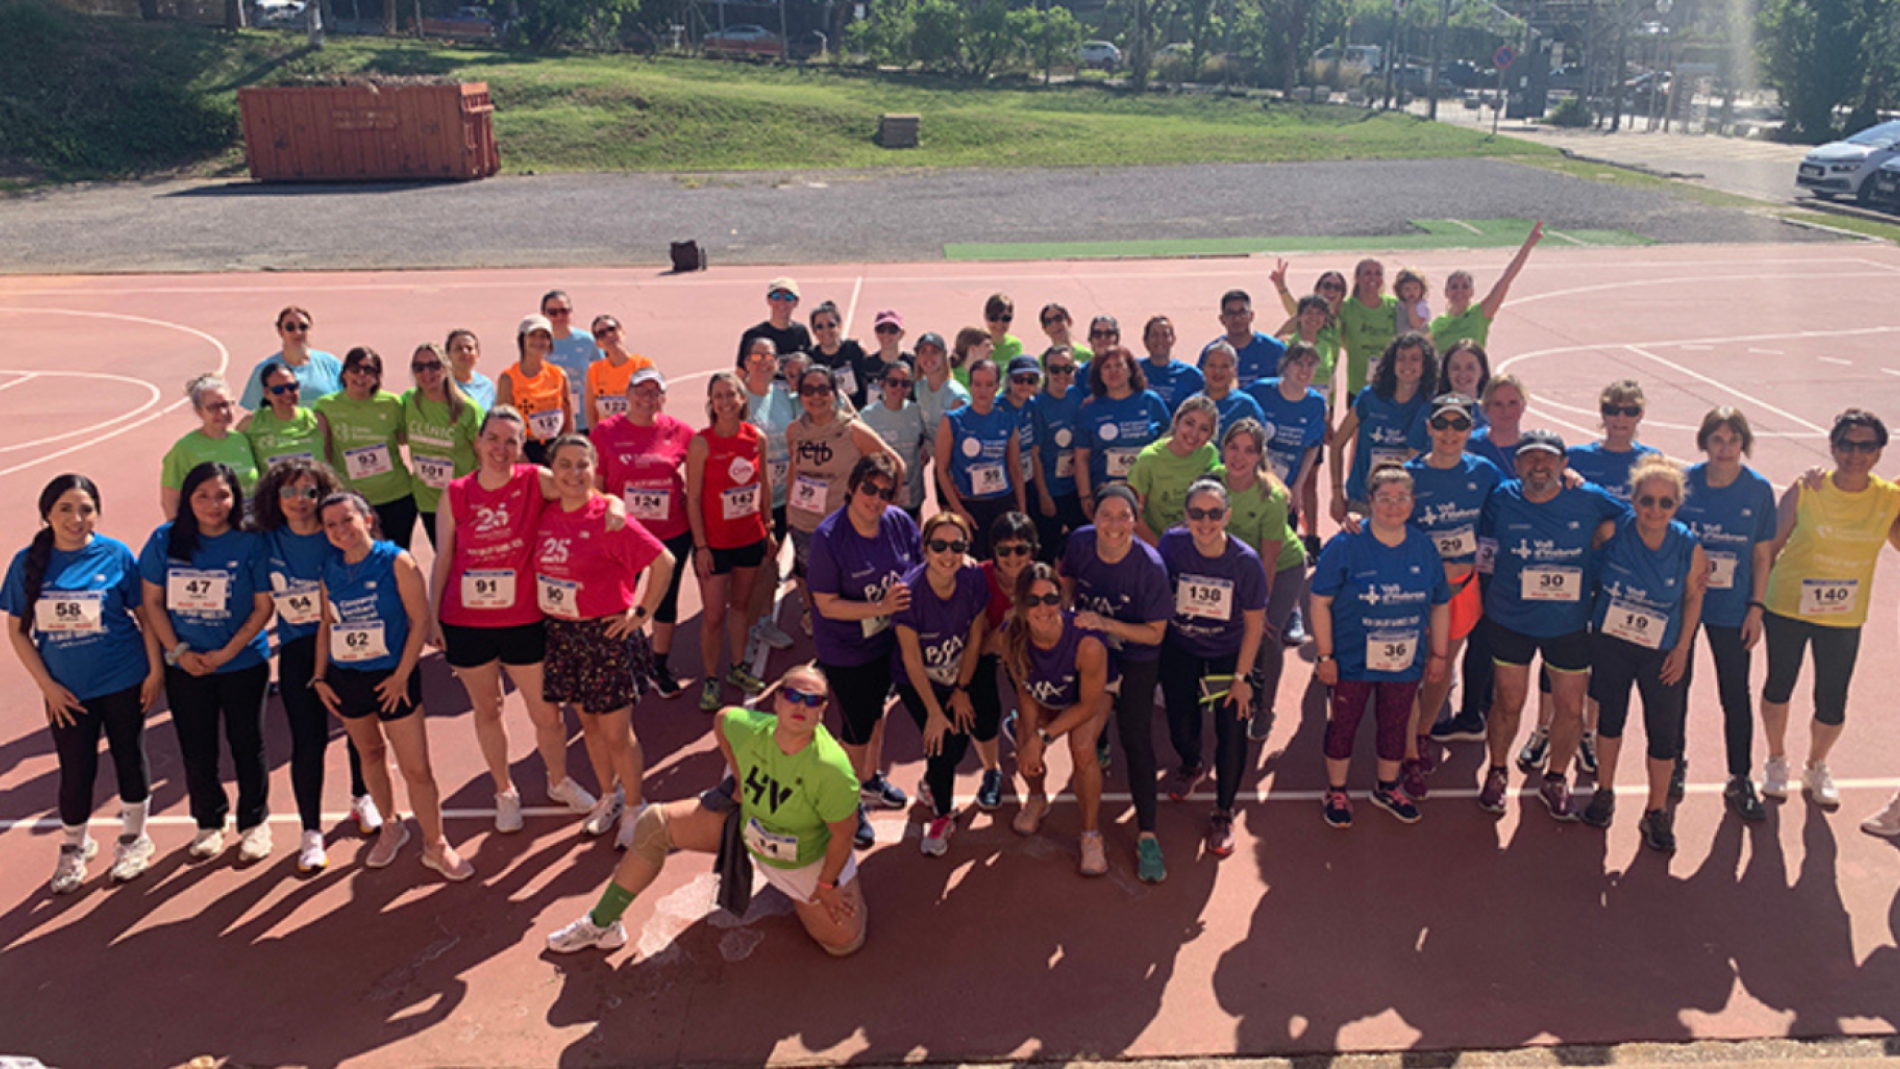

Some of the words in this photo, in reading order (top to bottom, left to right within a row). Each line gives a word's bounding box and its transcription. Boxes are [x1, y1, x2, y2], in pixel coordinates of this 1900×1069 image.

[421, 464, 444, 478] 101
[634, 494, 661, 507] 124
[1440, 539, 1462, 552] 29
[186, 580, 211, 594] 47
[475, 579, 497, 593] 91
[1539, 573, 1564, 588] 30
[1814, 587, 1848, 601] 140
[55, 602, 82, 617] 58
[1625, 612, 1649, 629] 19
[346, 632, 369, 647] 62
[1384, 643, 1407, 657] 36
